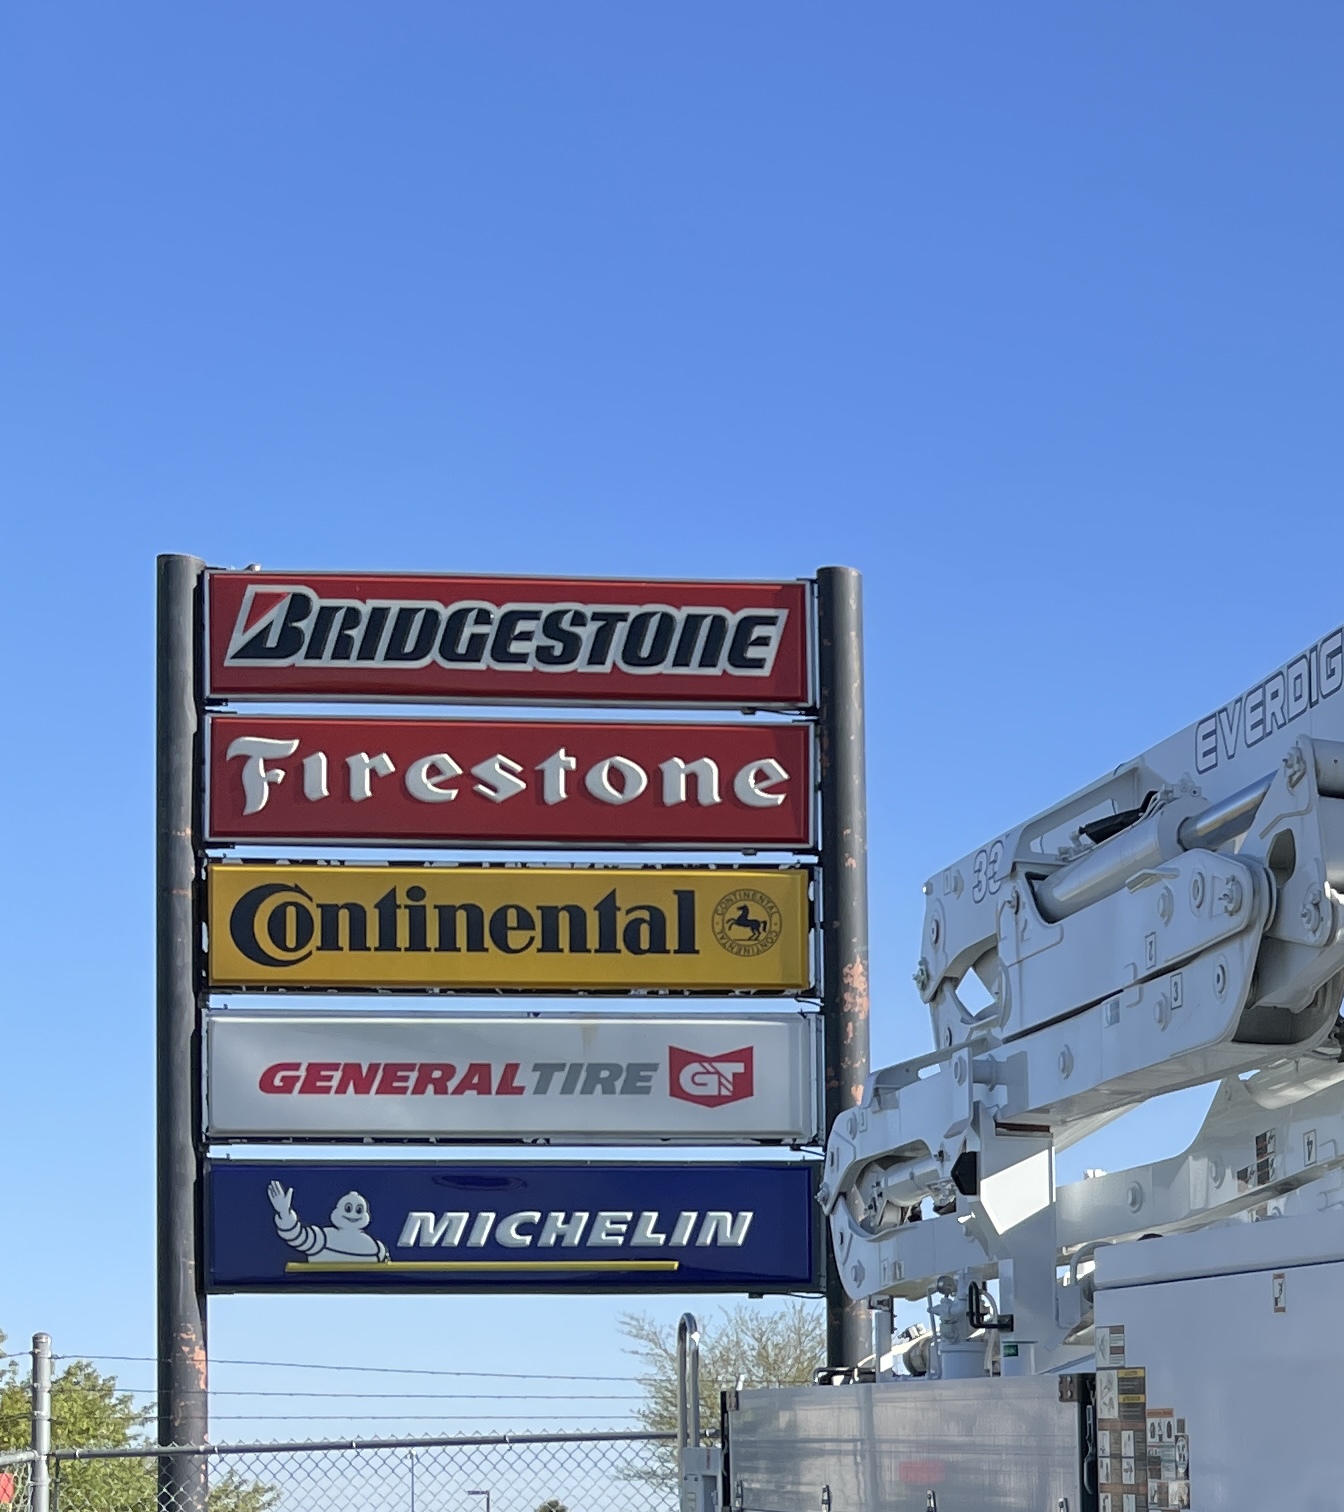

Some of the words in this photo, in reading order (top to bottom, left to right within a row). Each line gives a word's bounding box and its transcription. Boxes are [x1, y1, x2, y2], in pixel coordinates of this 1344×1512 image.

[226, 585, 788, 676] BRIDGESTONE
[226, 736, 790, 816] Firestone
[229, 883, 700, 968] Continental
[715, 890, 780, 921] CONTINENTAL
[397, 1210, 754, 1248] MICHELIN
